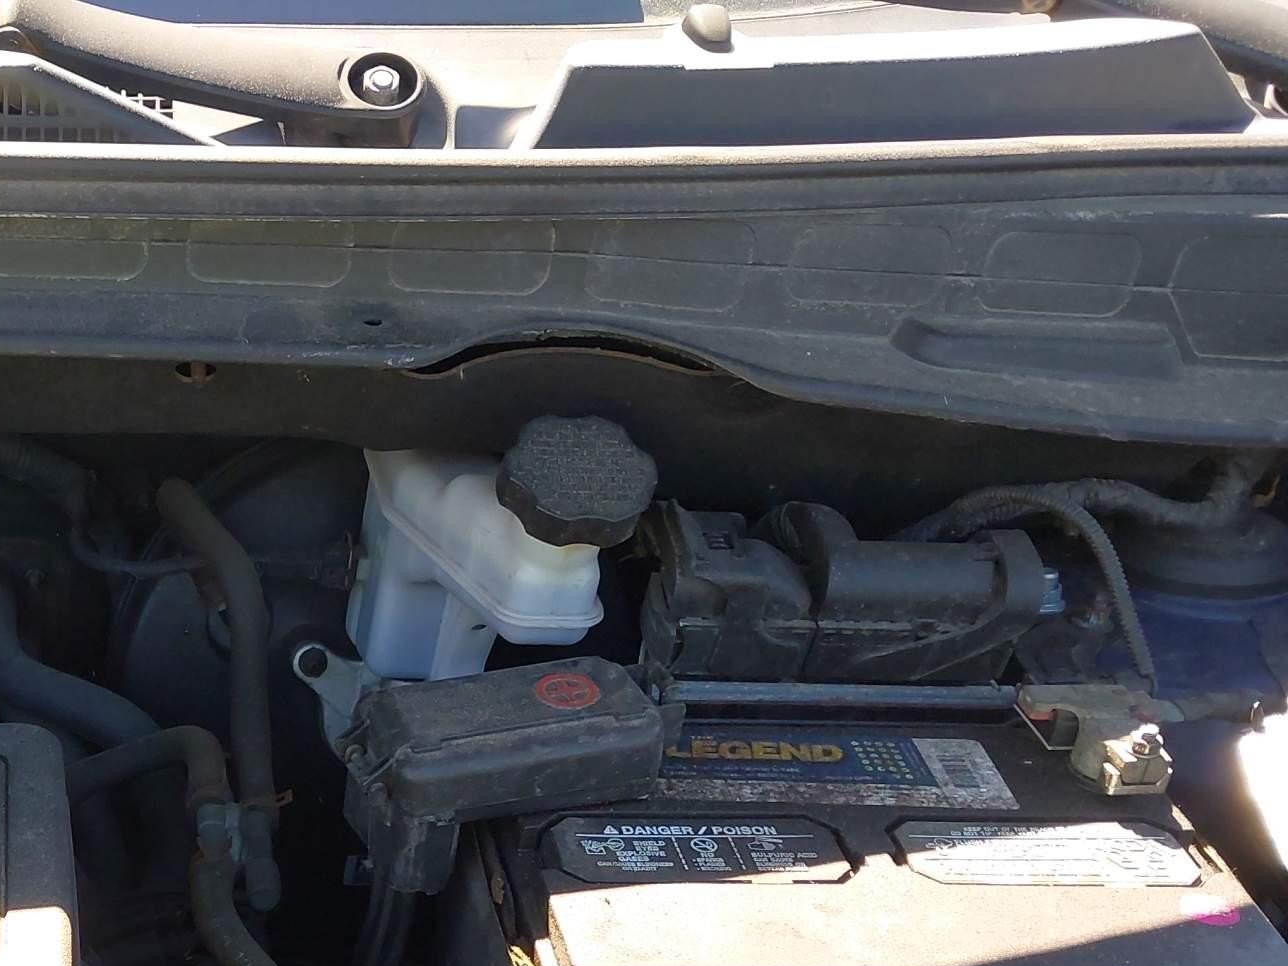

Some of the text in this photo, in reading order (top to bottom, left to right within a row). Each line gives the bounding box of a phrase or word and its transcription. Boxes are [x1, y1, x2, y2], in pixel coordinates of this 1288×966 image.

[665, 739, 844, 763] LEGEND
[621, 826, 694, 835] DANGER
[712, 826, 777, 835] POISON
